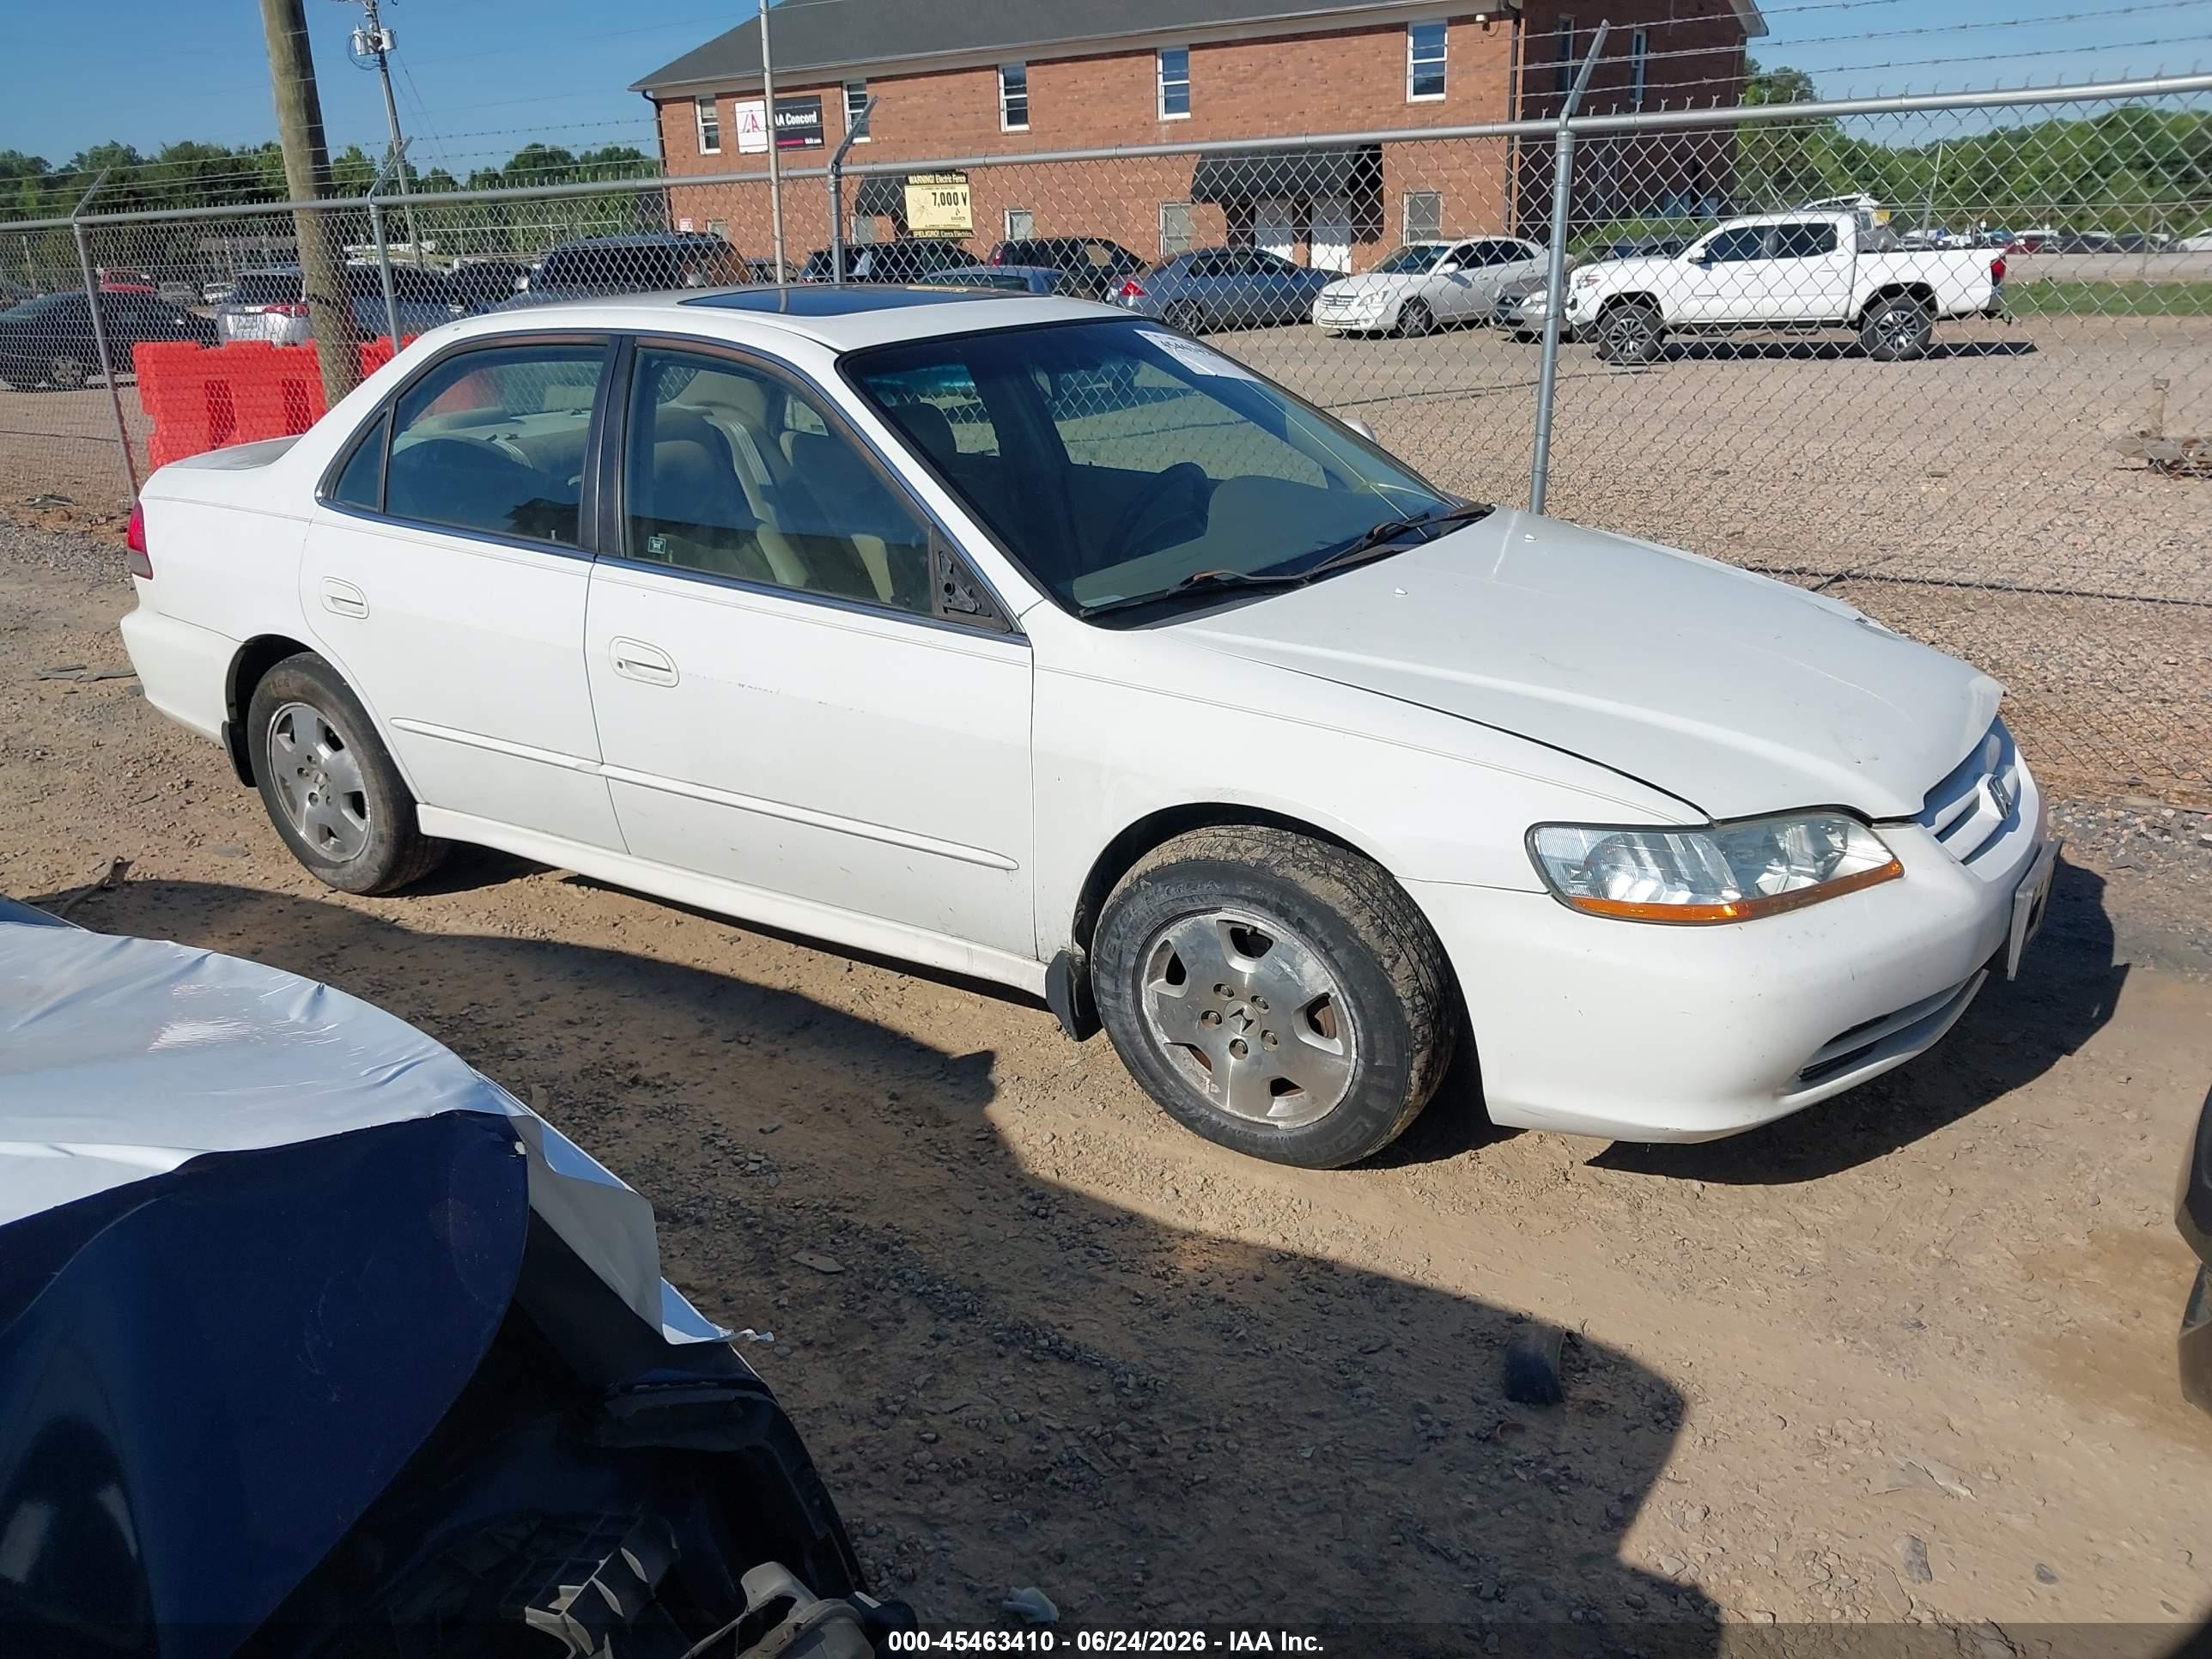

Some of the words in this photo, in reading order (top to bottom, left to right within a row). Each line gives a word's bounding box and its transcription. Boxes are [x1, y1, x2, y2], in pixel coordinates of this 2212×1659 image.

[786, 111, 817, 125] Concord
[908, 174, 934, 184] WARNING!
[935, 173, 952, 184] Electric
[952, 173, 966, 184] Fence
[931, 191, 959, 208] 7,000
[961, 191, 968, 207] V
